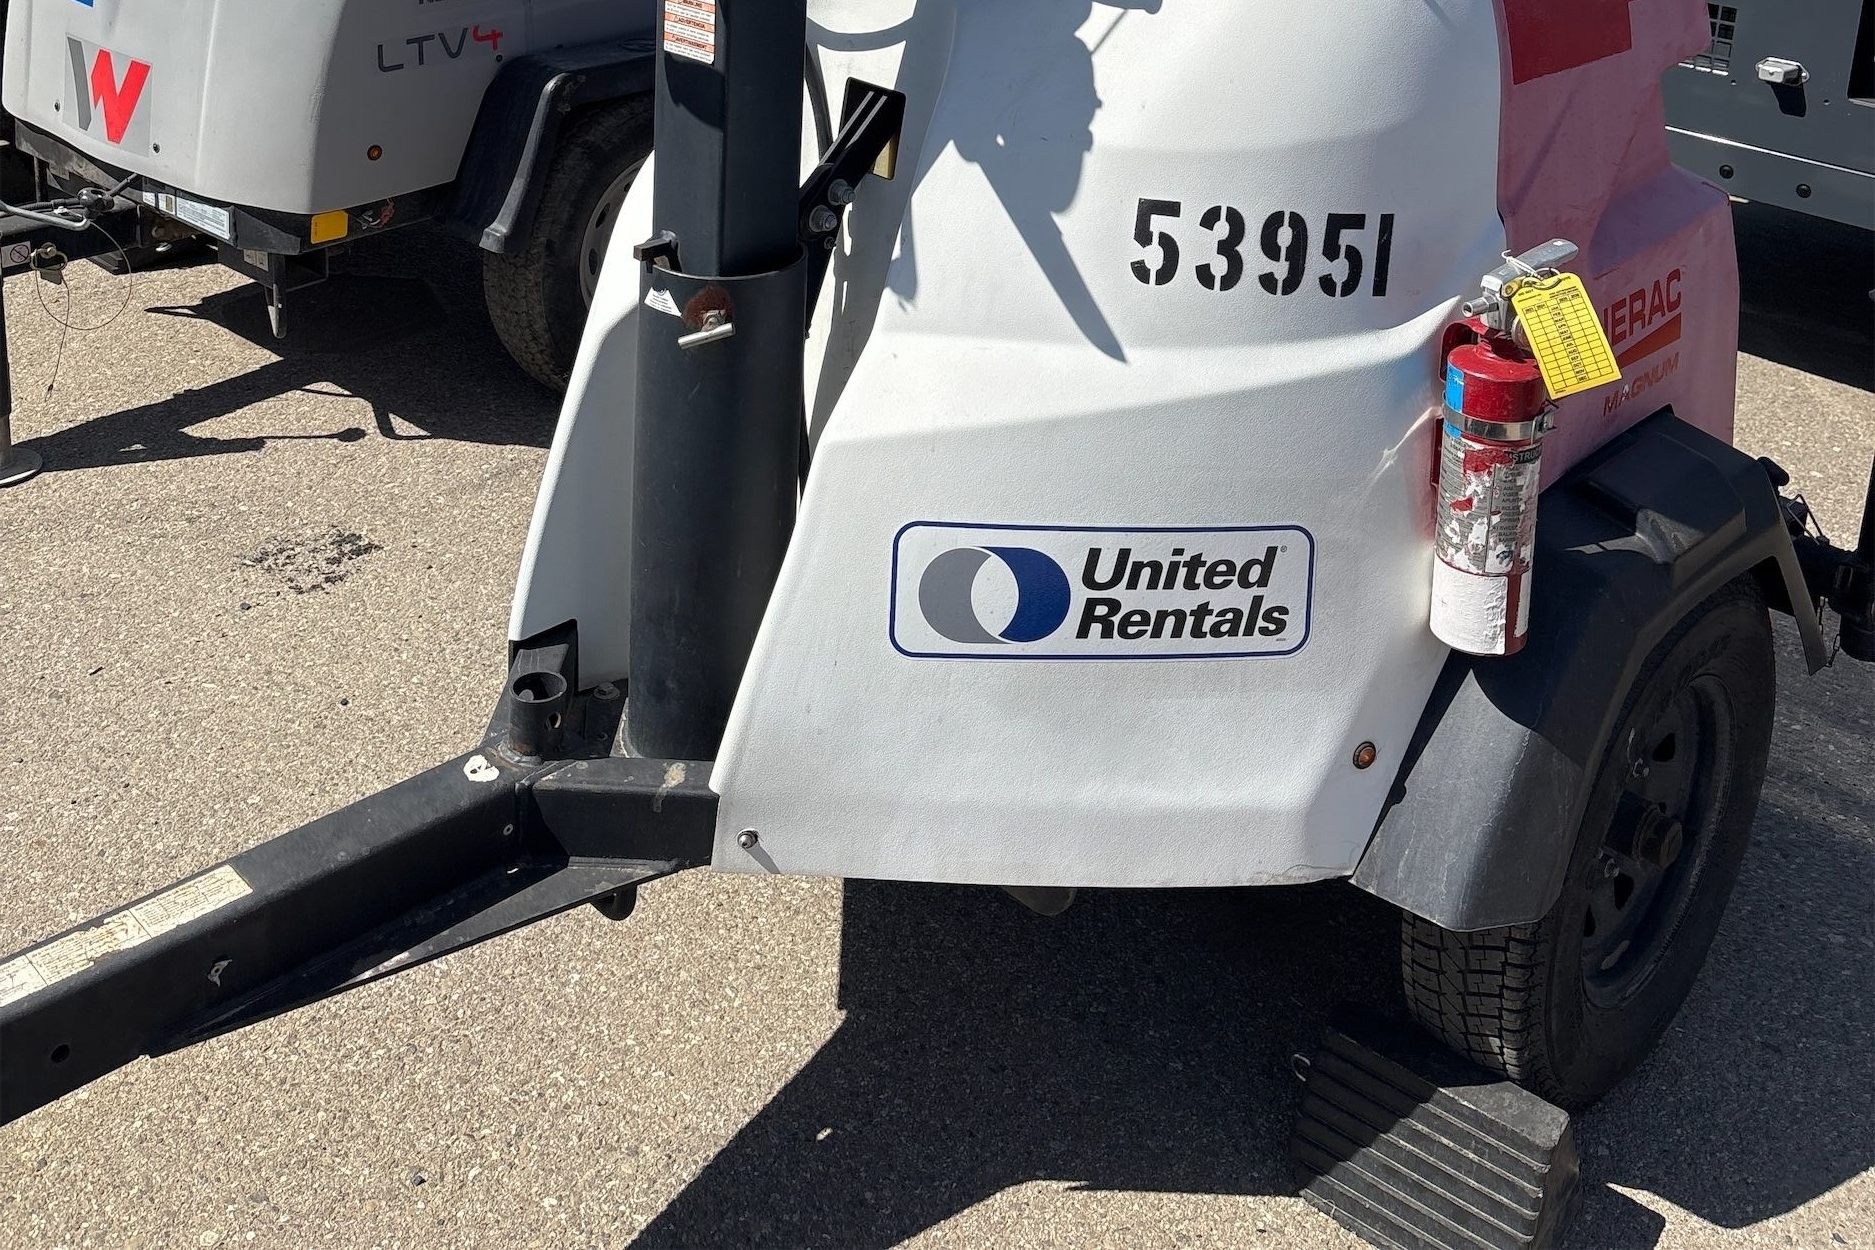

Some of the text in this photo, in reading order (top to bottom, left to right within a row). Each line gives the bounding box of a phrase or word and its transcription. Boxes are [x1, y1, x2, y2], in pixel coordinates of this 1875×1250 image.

[1130, 197, 1395, 298] 53951
[1603, 352, 1680, 417] MAGNUM
[1081, 545, 1279, 591] United
[1075, 594, 1290, 640] Rentals
